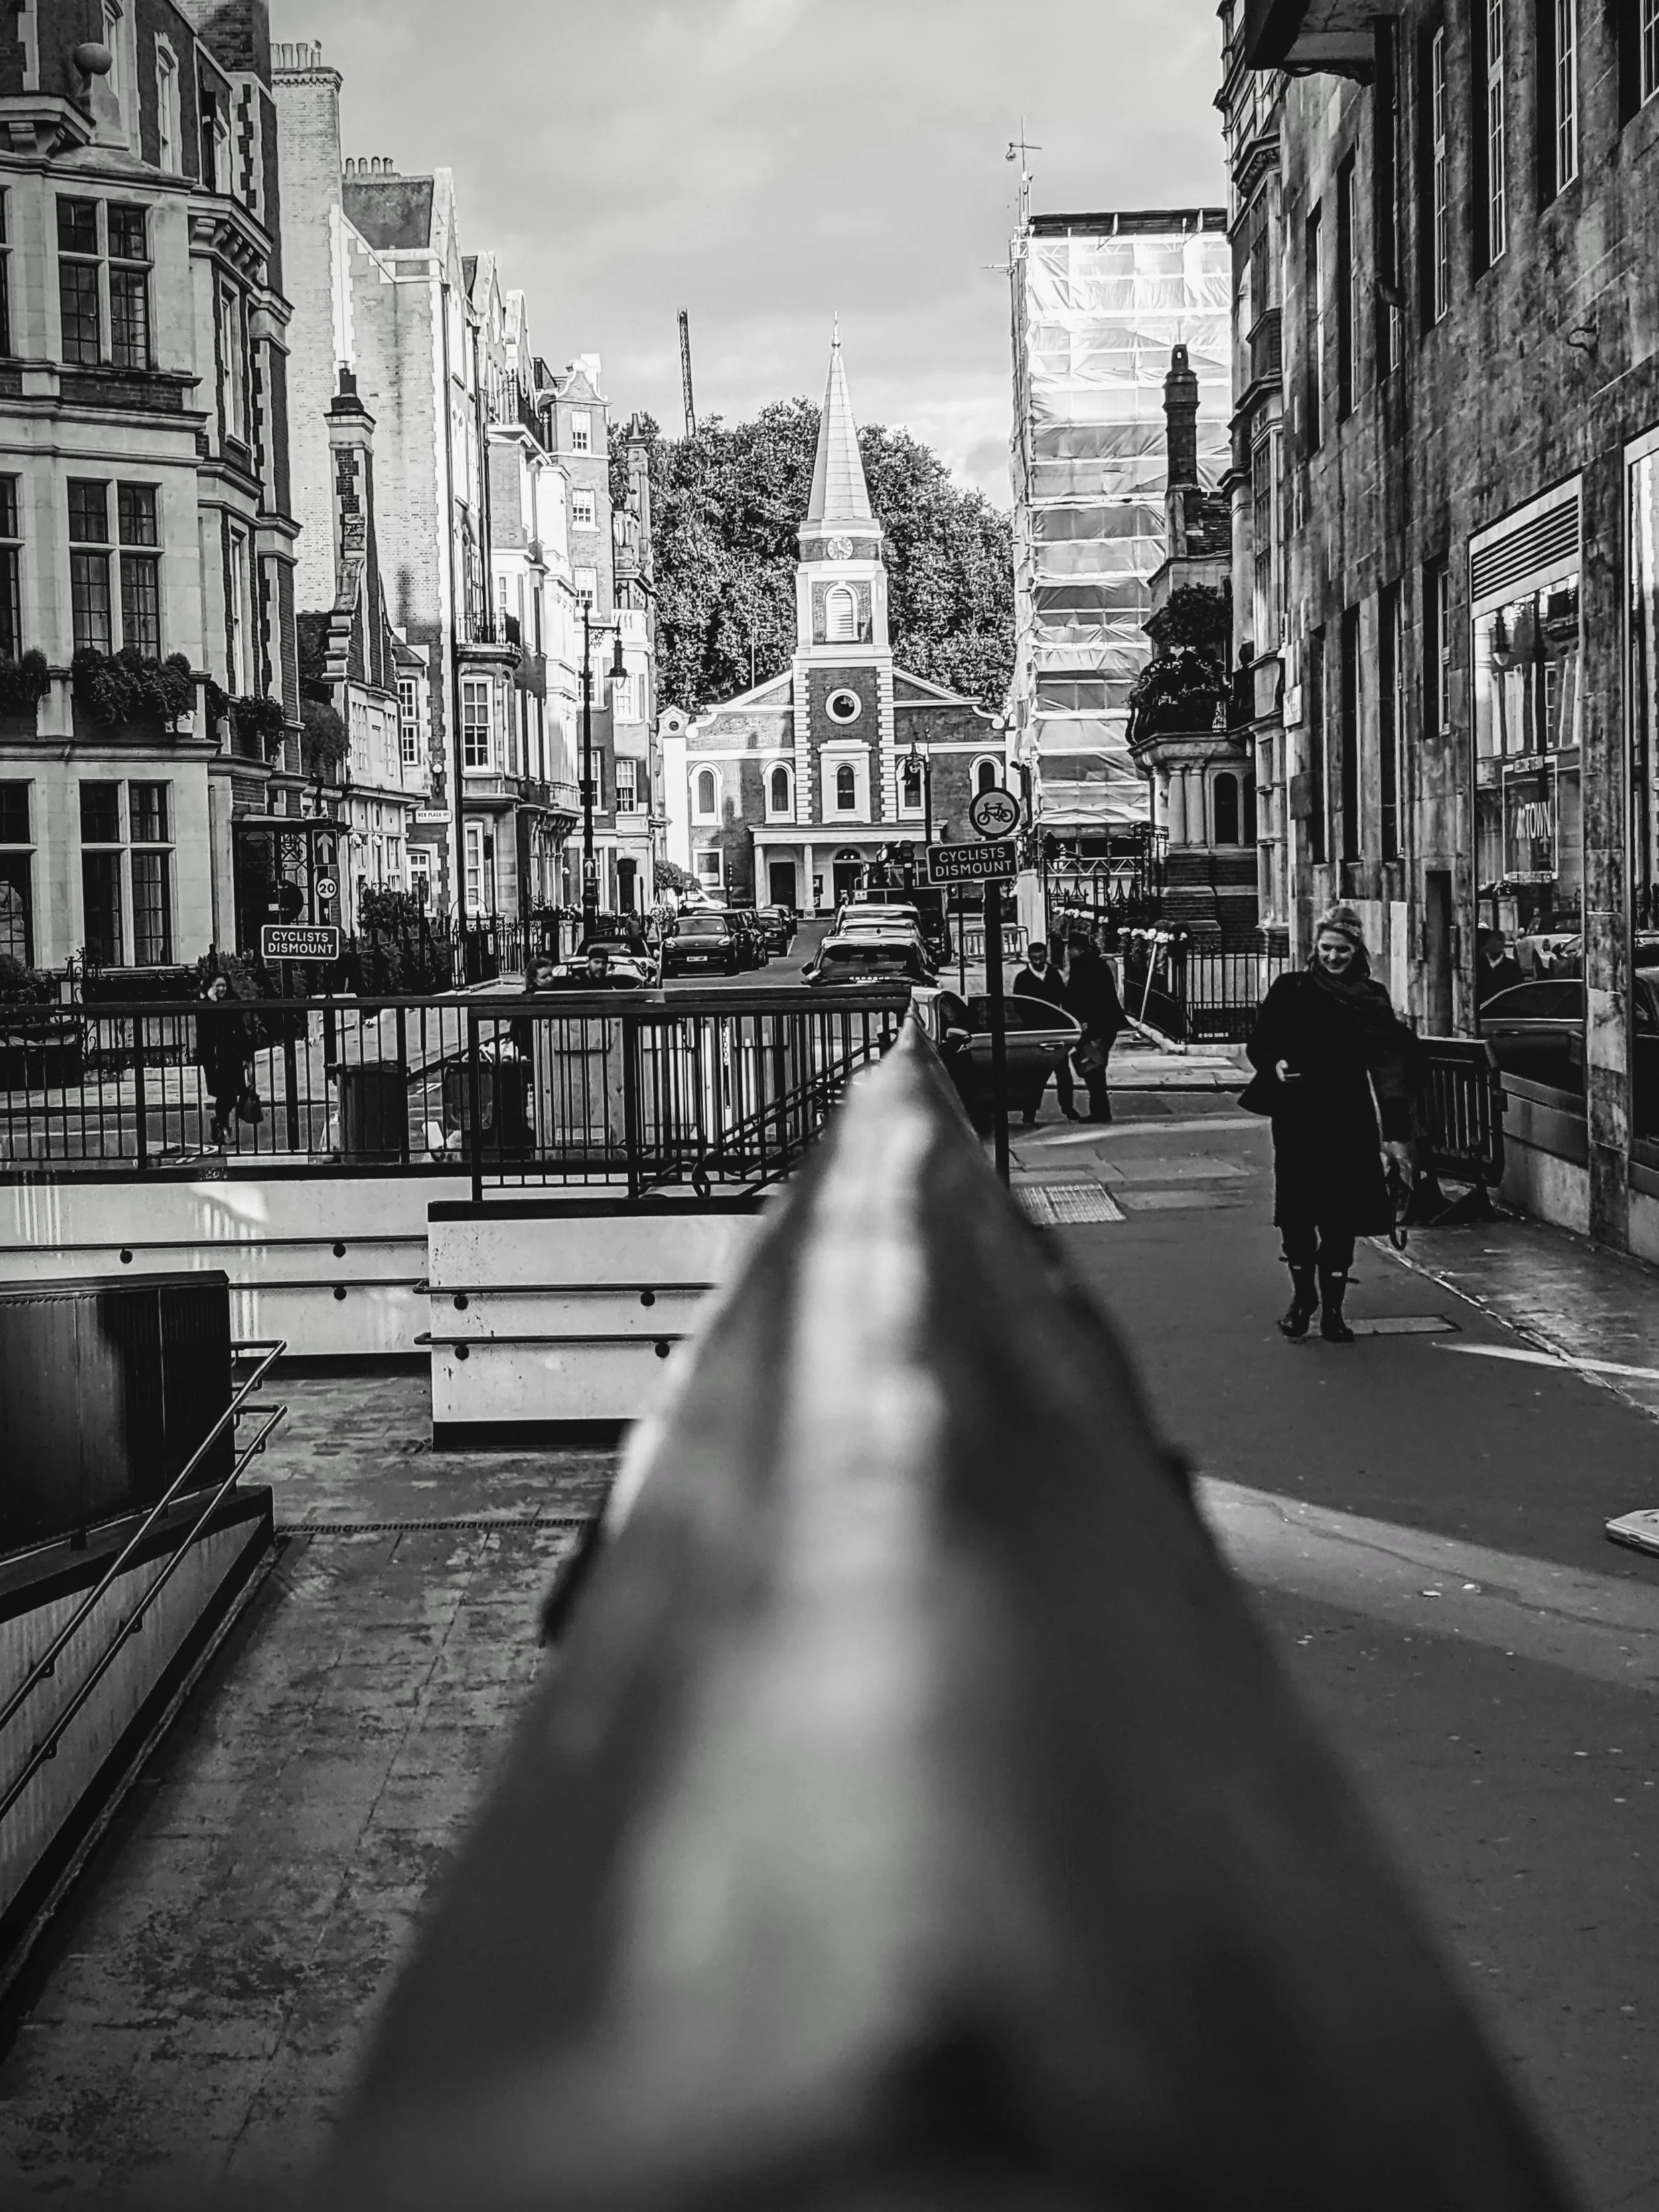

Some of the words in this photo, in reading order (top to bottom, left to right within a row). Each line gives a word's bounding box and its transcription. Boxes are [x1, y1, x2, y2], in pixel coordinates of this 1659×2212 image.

[939, 847, 1005, 863] CYCLISTS
[935, 860, 1012, 877] DISMOUNT
[319, 883, 335, 893] 20
[272, 931, 329, 942] CYCLISTS
[268, 942, 333, 954] DISMOUNT
